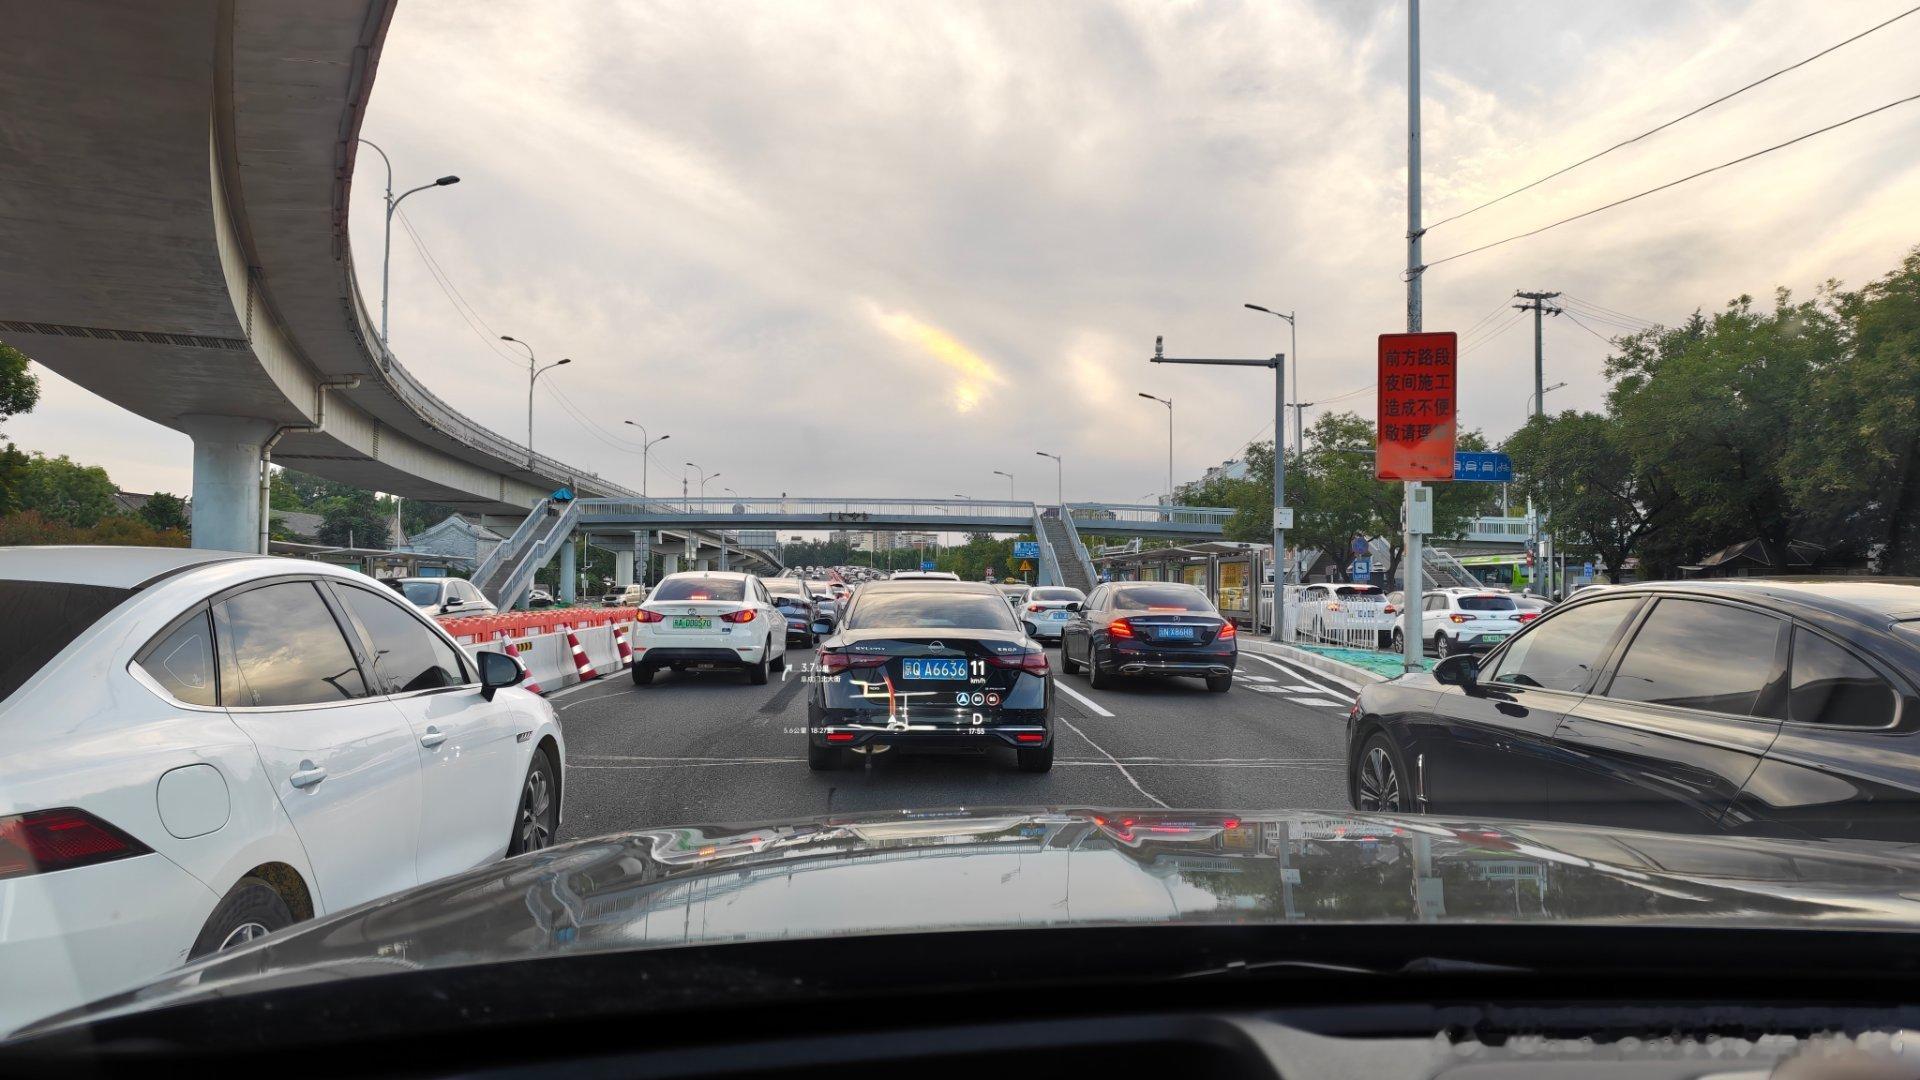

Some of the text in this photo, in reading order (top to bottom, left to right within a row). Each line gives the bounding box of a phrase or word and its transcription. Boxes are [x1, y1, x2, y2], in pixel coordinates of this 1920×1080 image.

[1385, 347, 1450, 367] 前方路段
[1385, 374, 1450, 391] 夜间施工
[1385, 398, 1450, 417] 造成不便
[1385, 423, 1446, 442] 敬请理
[970, 660, 985, 676] 11
[972, 713, 983, 725] D
